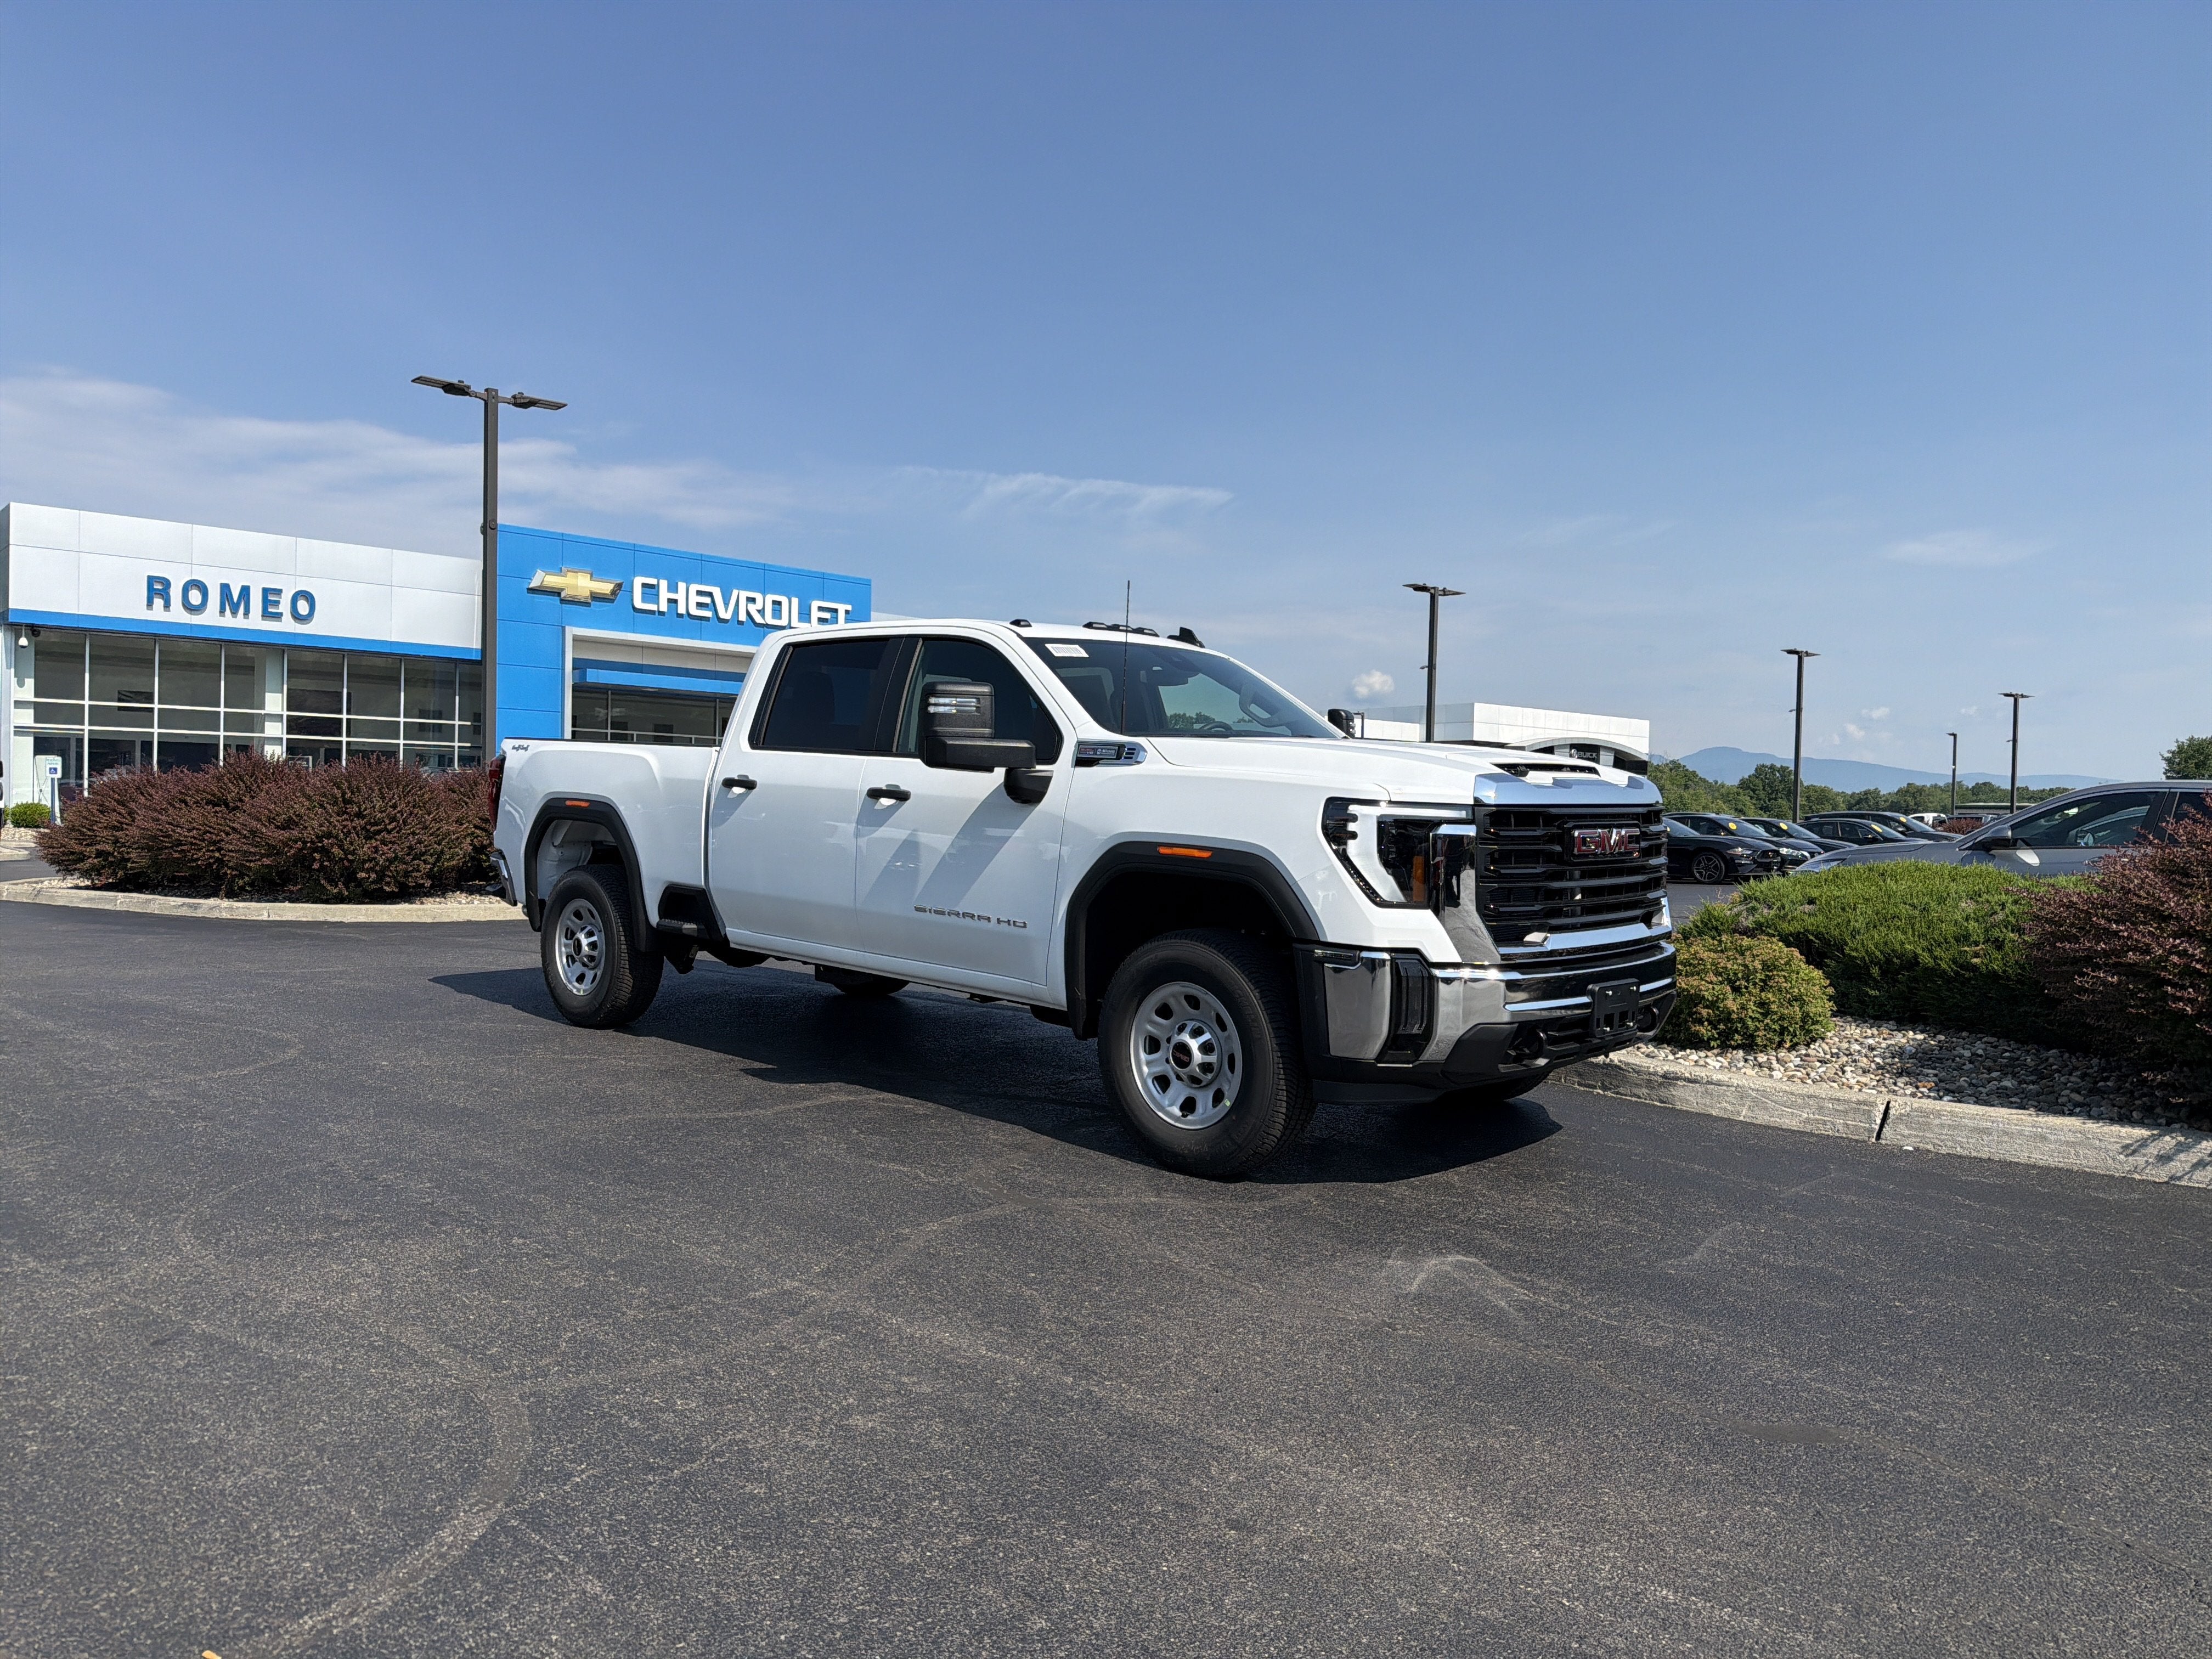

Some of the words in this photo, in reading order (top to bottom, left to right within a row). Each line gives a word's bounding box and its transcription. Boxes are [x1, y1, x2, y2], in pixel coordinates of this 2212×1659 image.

[146, 574, 316, 622] ROMEO
[633, 575, 852, 628] CHEVROLET
[1573, 827, 1640, 855] GMC
[913, 904, 992, 923] SIERRA
[996, 917, 1028, 929] HD
